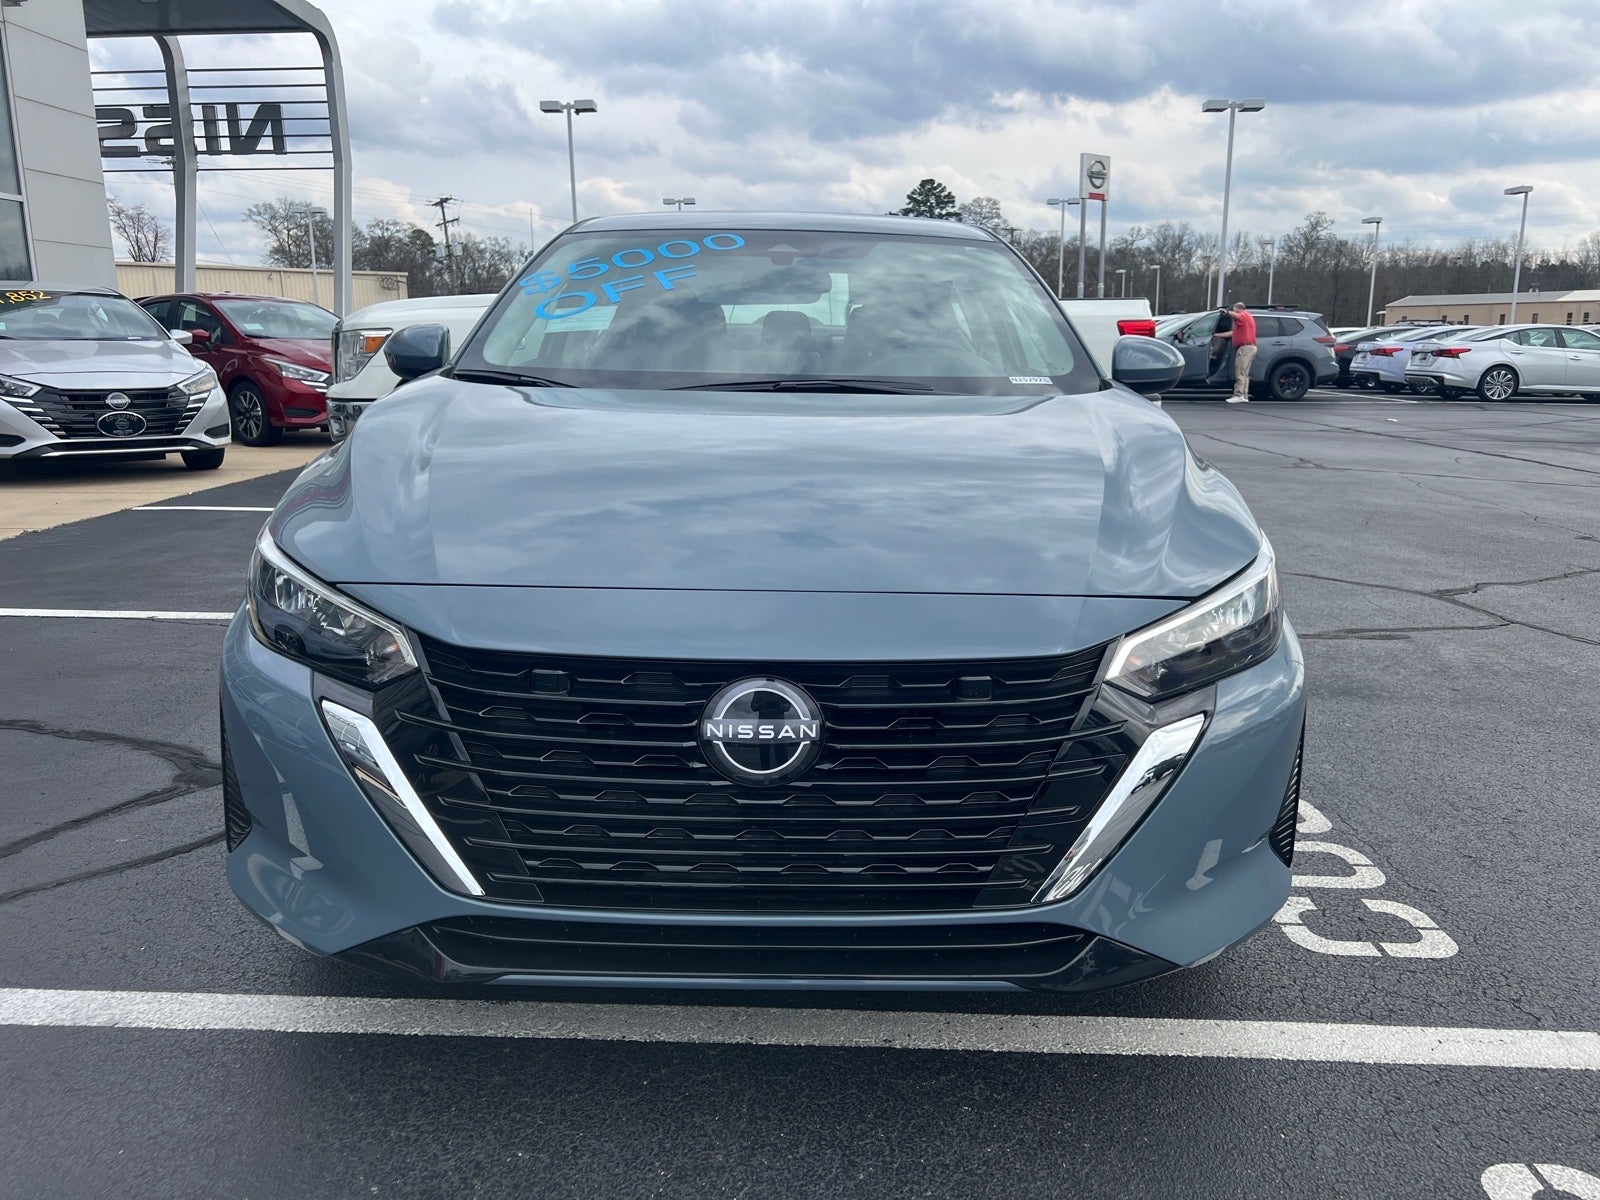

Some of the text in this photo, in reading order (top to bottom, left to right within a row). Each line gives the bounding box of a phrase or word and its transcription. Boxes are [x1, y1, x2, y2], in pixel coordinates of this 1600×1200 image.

[519, 233, 745, 295] $5000
[534, 264, 697, 320] OFF
[706, 723, 817, 739] NISSAN
